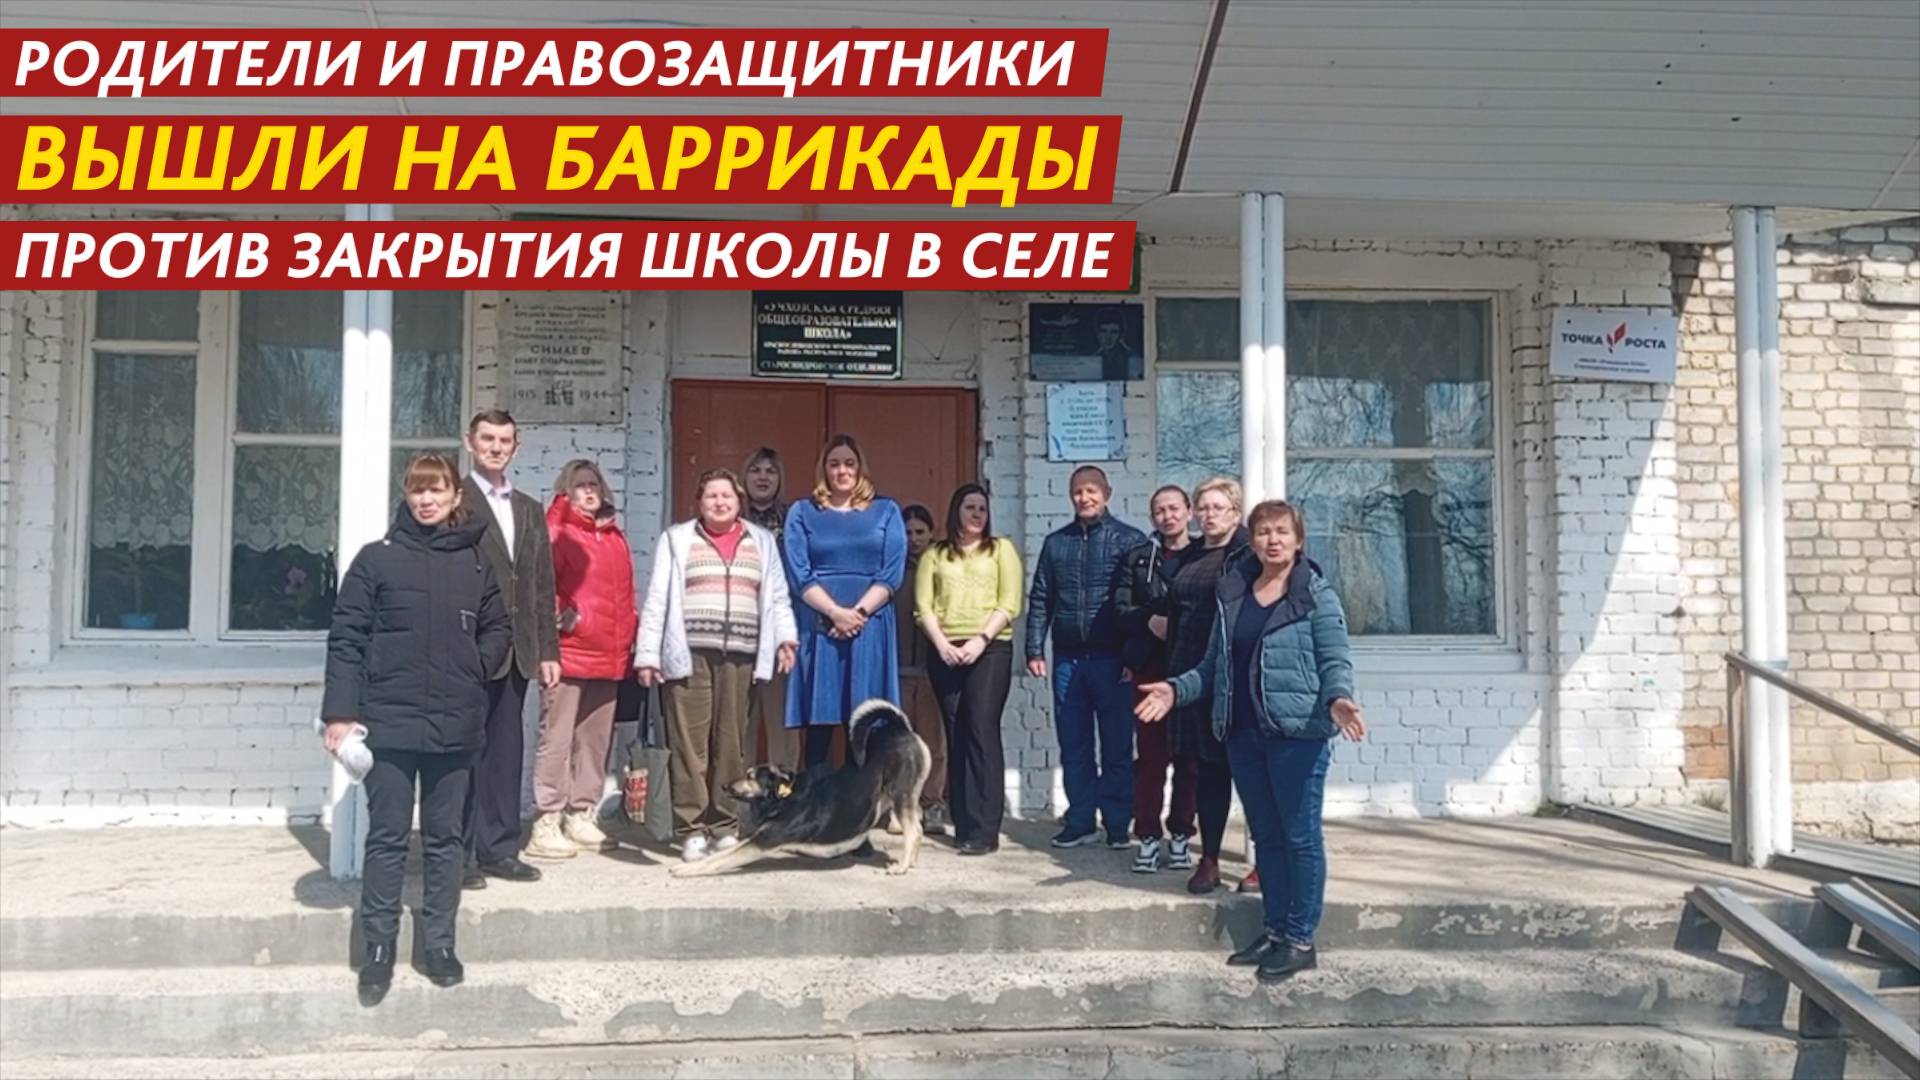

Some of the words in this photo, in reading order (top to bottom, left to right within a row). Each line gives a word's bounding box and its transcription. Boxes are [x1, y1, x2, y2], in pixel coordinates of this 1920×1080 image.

[840, 304, 891, 315] СРЕДНЯЯ
[758, 314, 896, 328] ОБЩЕОБРАЗОВАТЕЛЬНАЯ
[804, 327, 852, 339] ШКОЛА»
[1561, 332, 1603, 345] ТОЧКА
[1625, 337, 1667, 349] РОСТА
